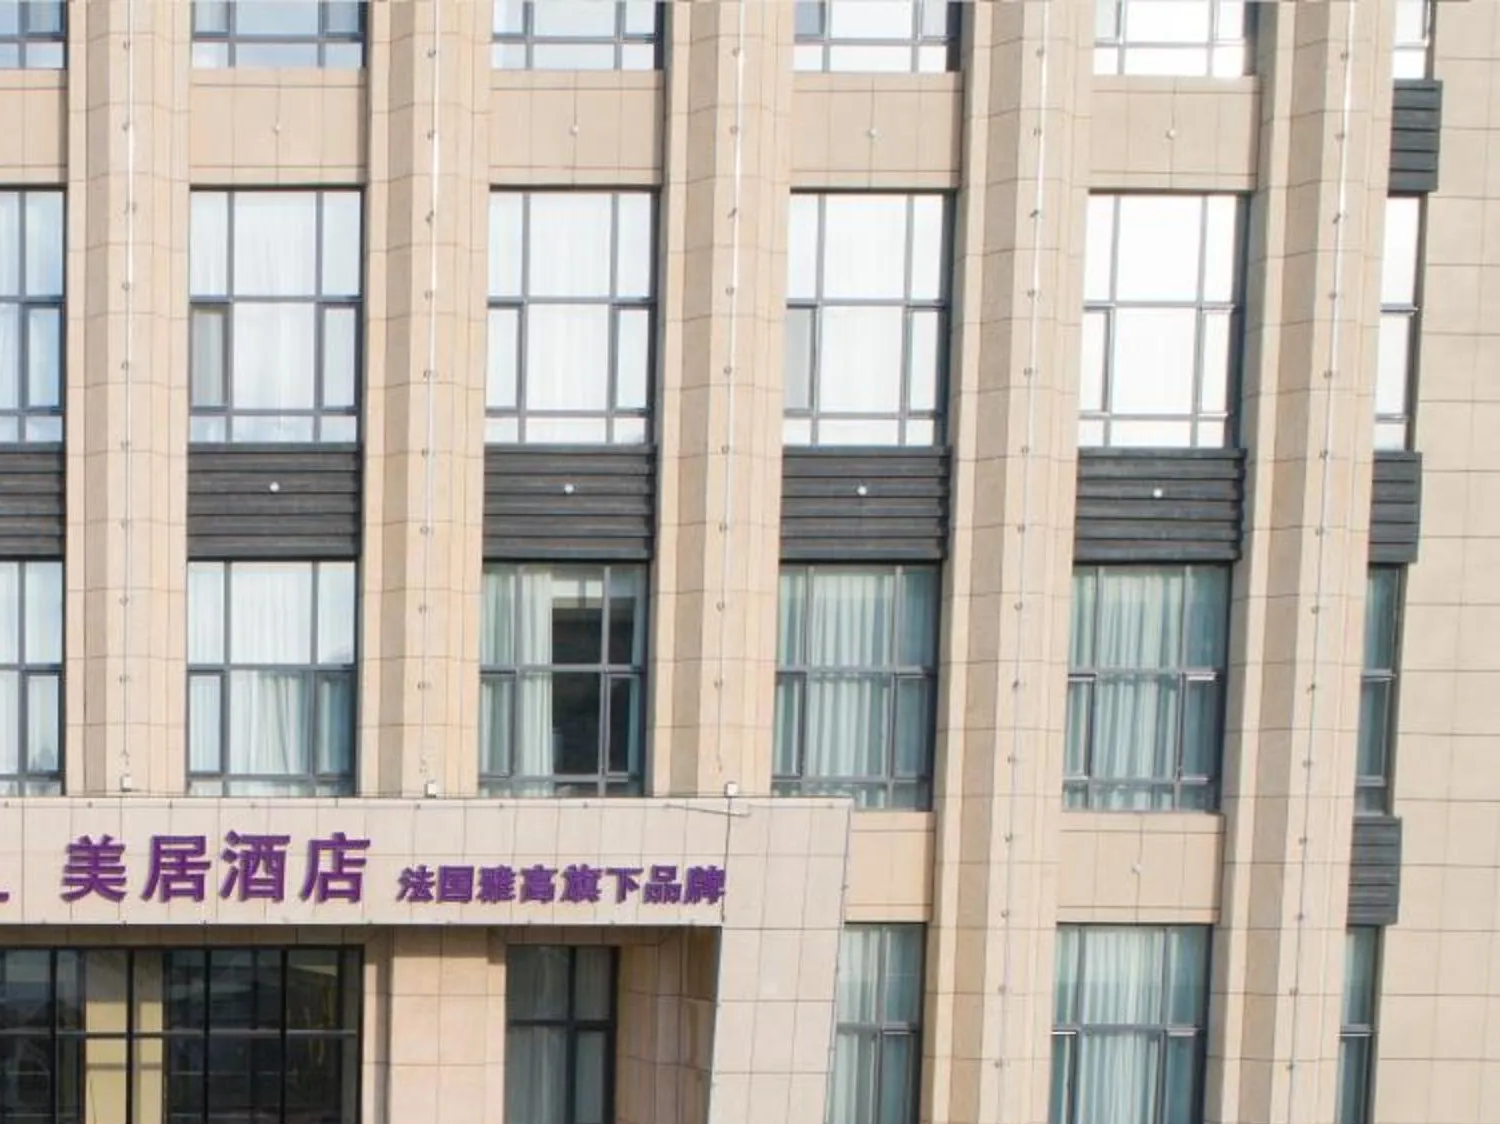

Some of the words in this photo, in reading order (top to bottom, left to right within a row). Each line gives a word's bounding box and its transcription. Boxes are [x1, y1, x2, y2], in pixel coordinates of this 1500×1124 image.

[59, 829, 371, 904] 美居酒店
[397, 863, 726, 905] 法国雅高旗下品牌
